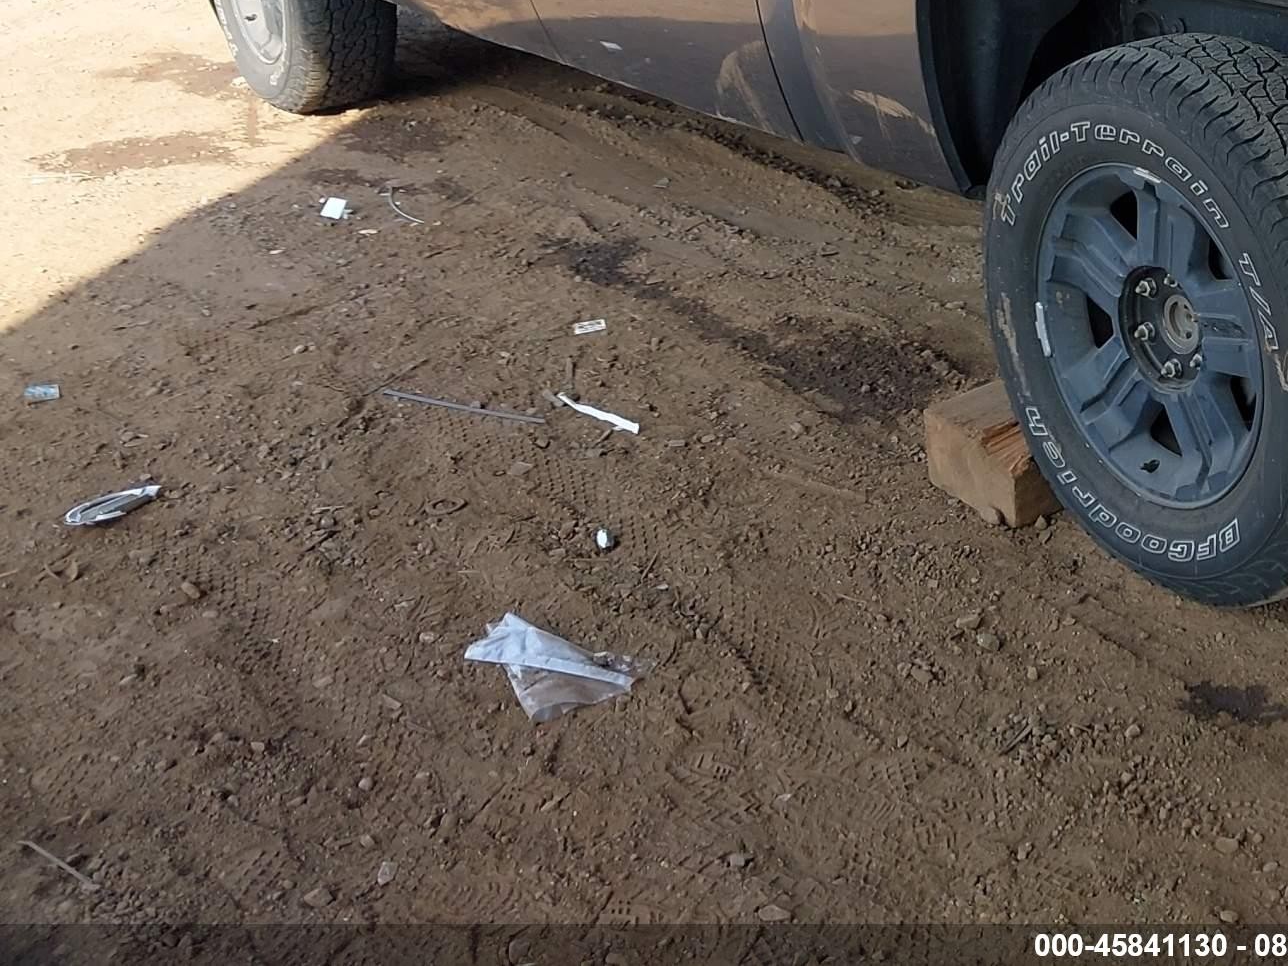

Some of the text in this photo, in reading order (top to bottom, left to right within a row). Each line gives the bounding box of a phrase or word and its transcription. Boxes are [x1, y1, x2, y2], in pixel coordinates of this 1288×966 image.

[1000, 121, 1279, 351] Trail-Terrain T/A
[1025, 407, 1241, 562] BFGoodrich
